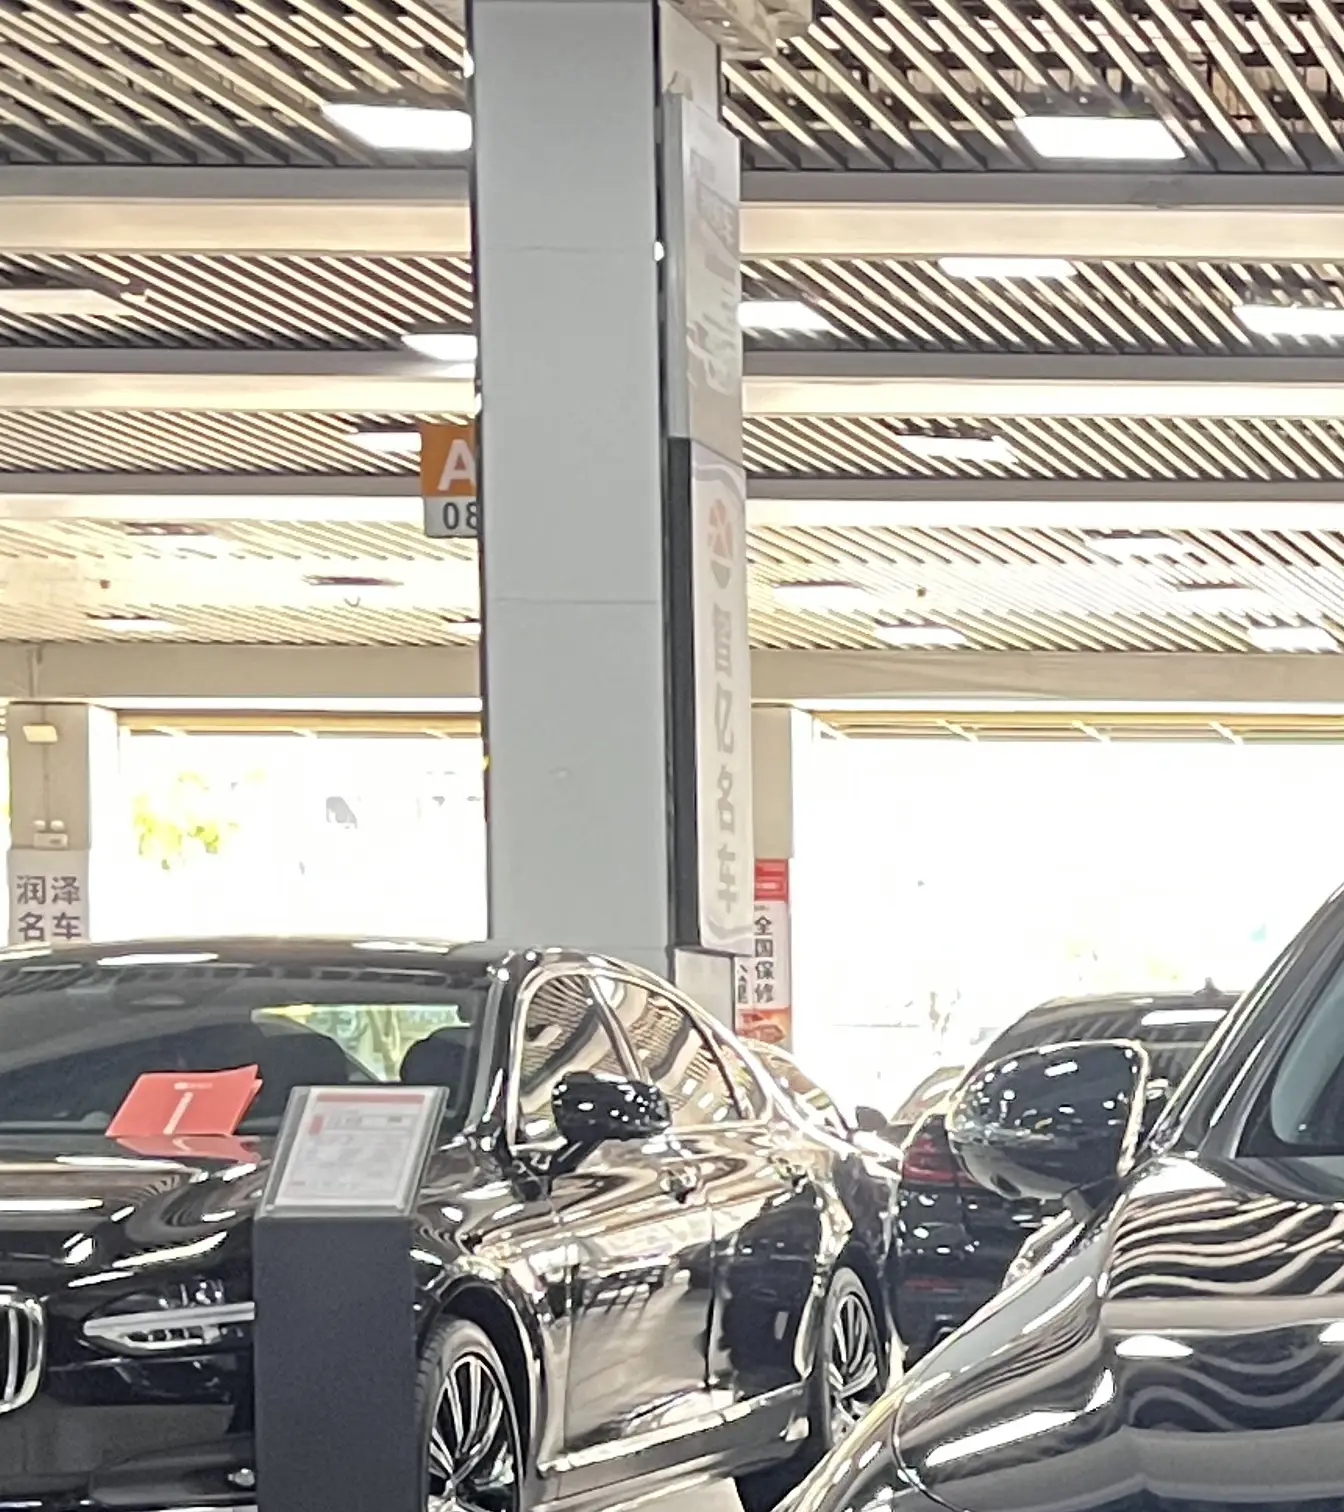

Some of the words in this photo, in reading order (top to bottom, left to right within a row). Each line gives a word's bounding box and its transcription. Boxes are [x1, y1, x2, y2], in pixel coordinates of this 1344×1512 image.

[438, 439, 477, 491] A
[16, 875, 81, 905] 润泽
[18, 911, 82, 941] 名车
[754, 915, 775, 1004] 全国保修
